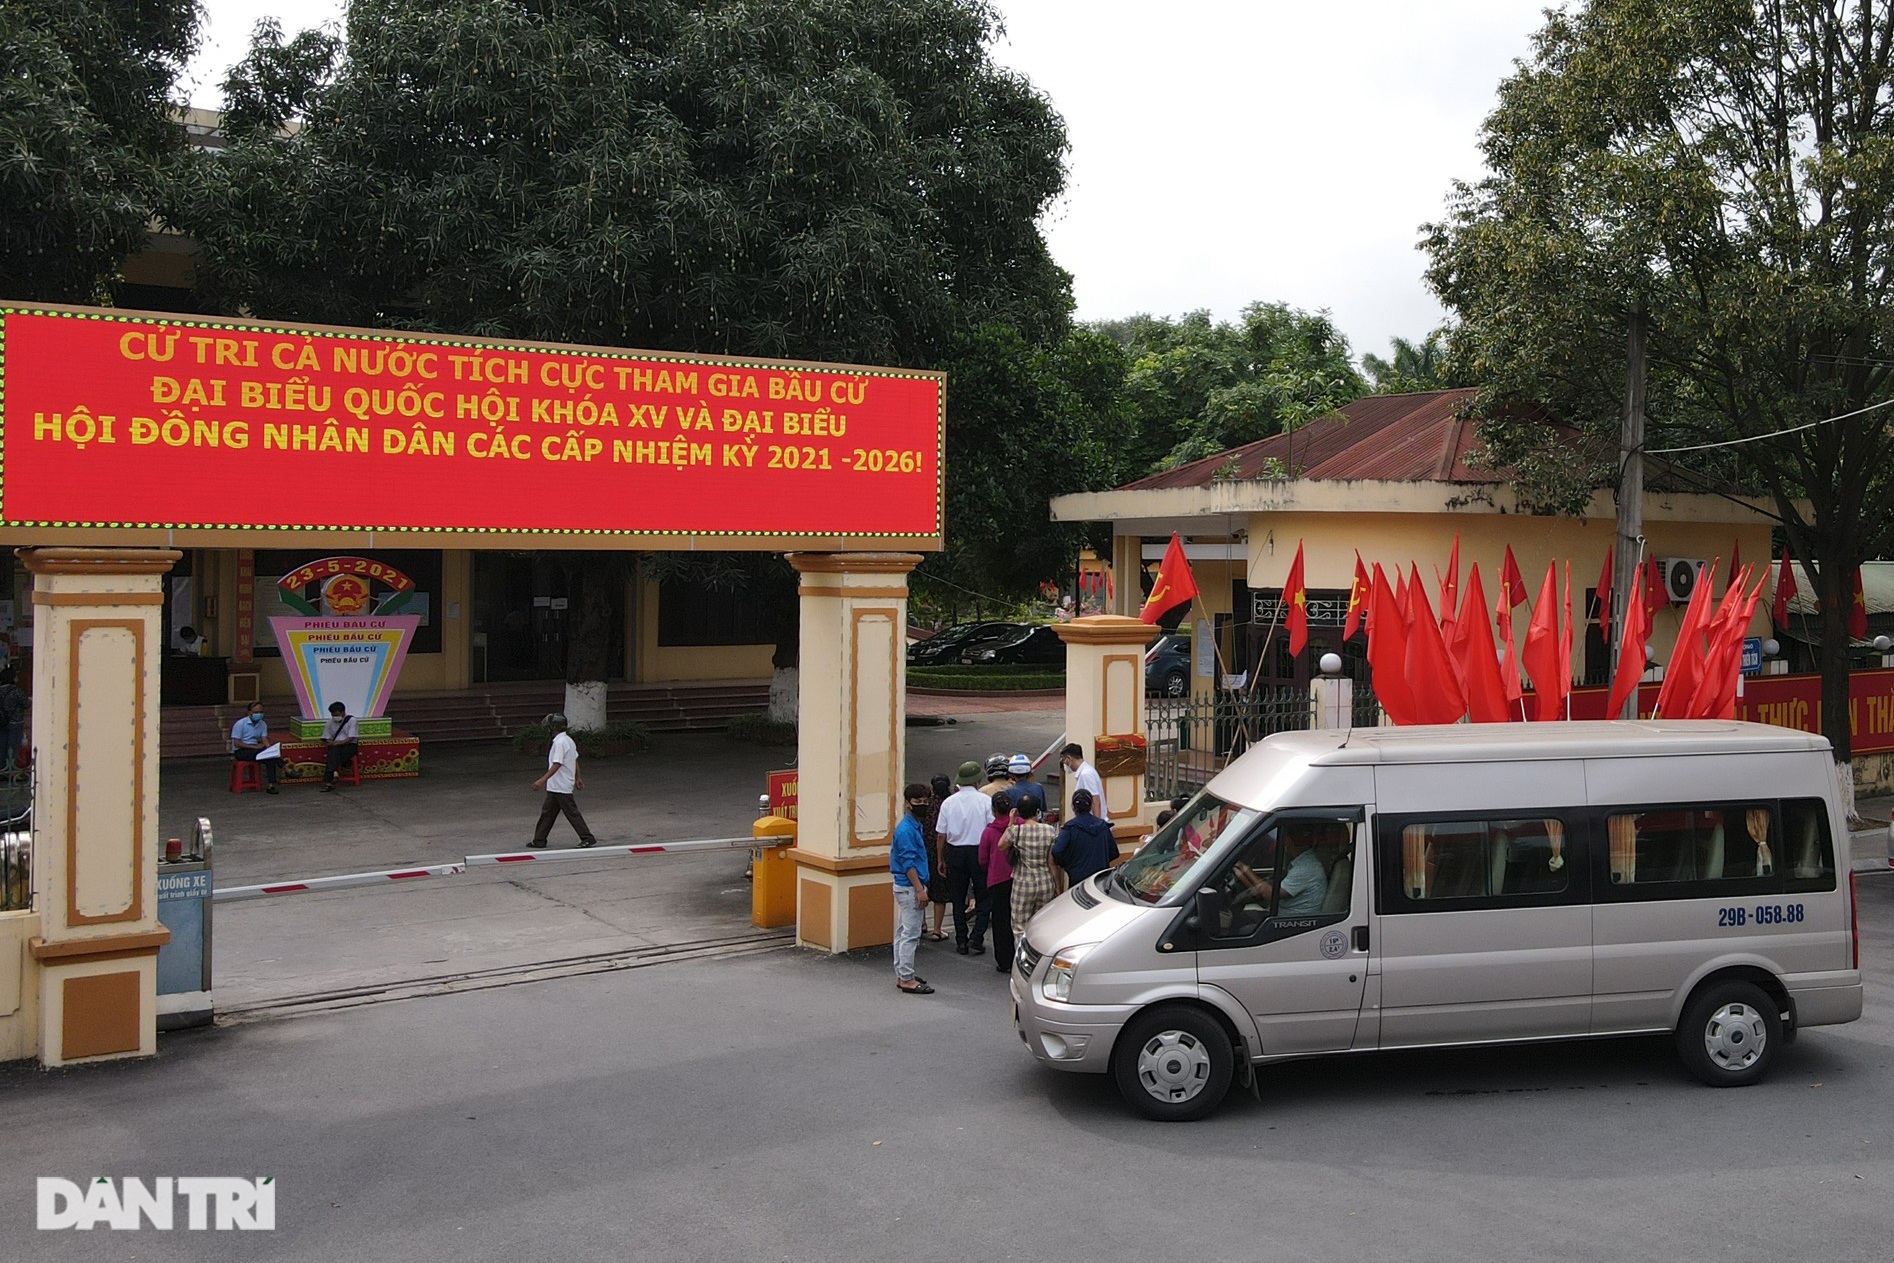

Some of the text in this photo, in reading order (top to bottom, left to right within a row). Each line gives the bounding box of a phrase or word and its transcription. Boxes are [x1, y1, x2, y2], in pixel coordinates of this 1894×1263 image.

[120, 325, 868, 404] CỬ TRI CẢ NƯỚC TÍCH CỰC THAM GIA BẦU CỬ
[150, 376, 846, 439] ĐẠI BIỂU QUỐC HỘI KHÓA XV VÀ ĐẠI BIỂU
[34, 405, 115, 449] HỘI
[129, 410, 248, 448] ĐỒNG
[264, 418, 368, 452] NHÂN
[384, 422, 454, 456] DÂN
[467, 426, 531, 459] CÁC
[542, 430, 602, 461] CẤP
[614, 434, 711, 470] NHIỆM
[723, 434, 759, 467] KỲ
[768, 446, 832, 469] 2021
[781, 776, 797, 797] XUỐ
[158, 874, 206, 890] XUỐNG XE
[1273, 920, 1317, 929] TRANSIT
